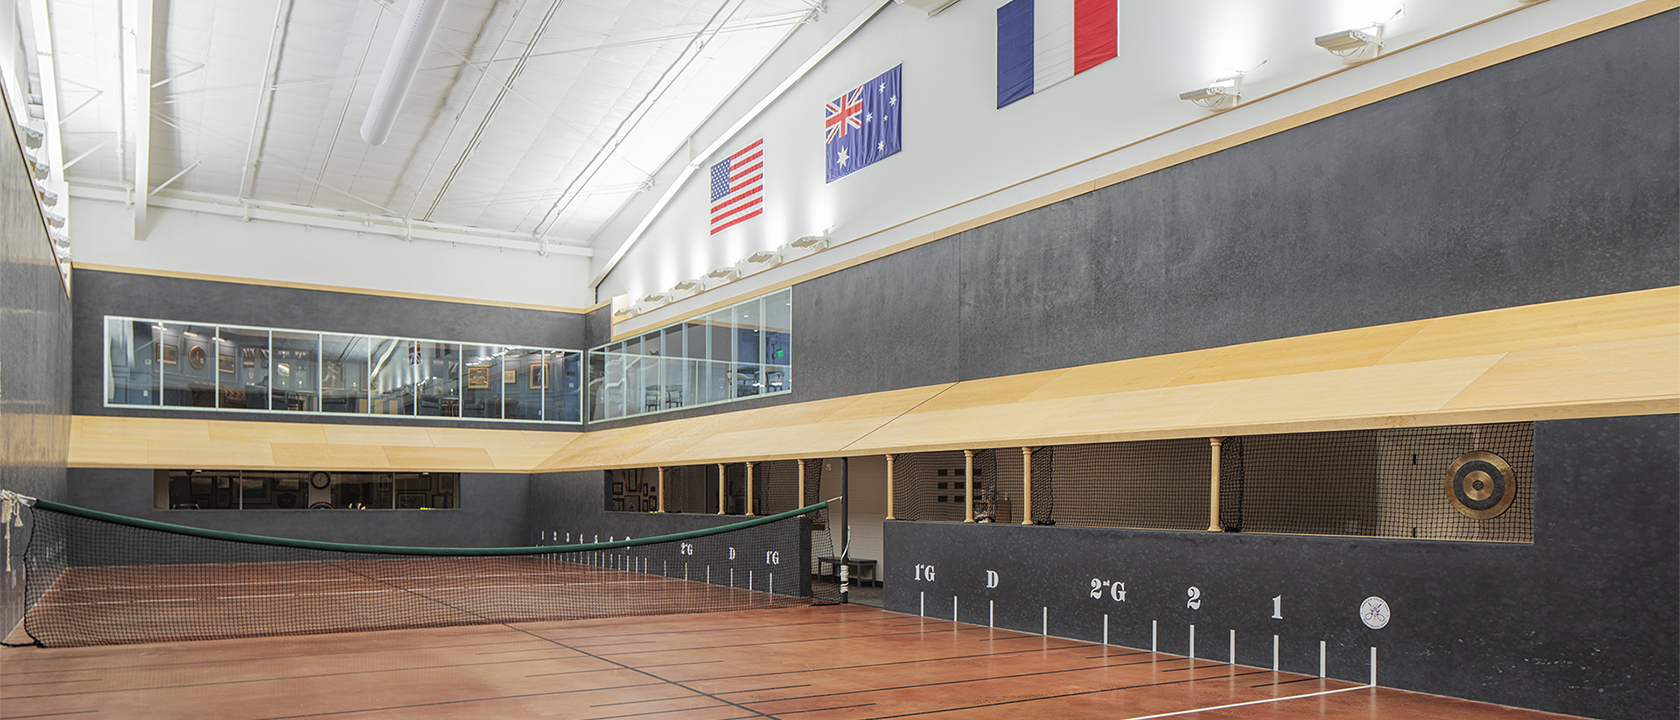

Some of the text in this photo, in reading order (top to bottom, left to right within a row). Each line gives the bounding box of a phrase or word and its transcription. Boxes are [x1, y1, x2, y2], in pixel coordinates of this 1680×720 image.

[541, 530, 545, 540] 1
[553, 530, 557, 541] 2
[566, 532, 570, 543] 3
[728, 546, 736, 560] D
[986, 569, 999, 589] D
[1187, 586, 1201, 611] 2
[1271, 594, 1283, 619] 1
